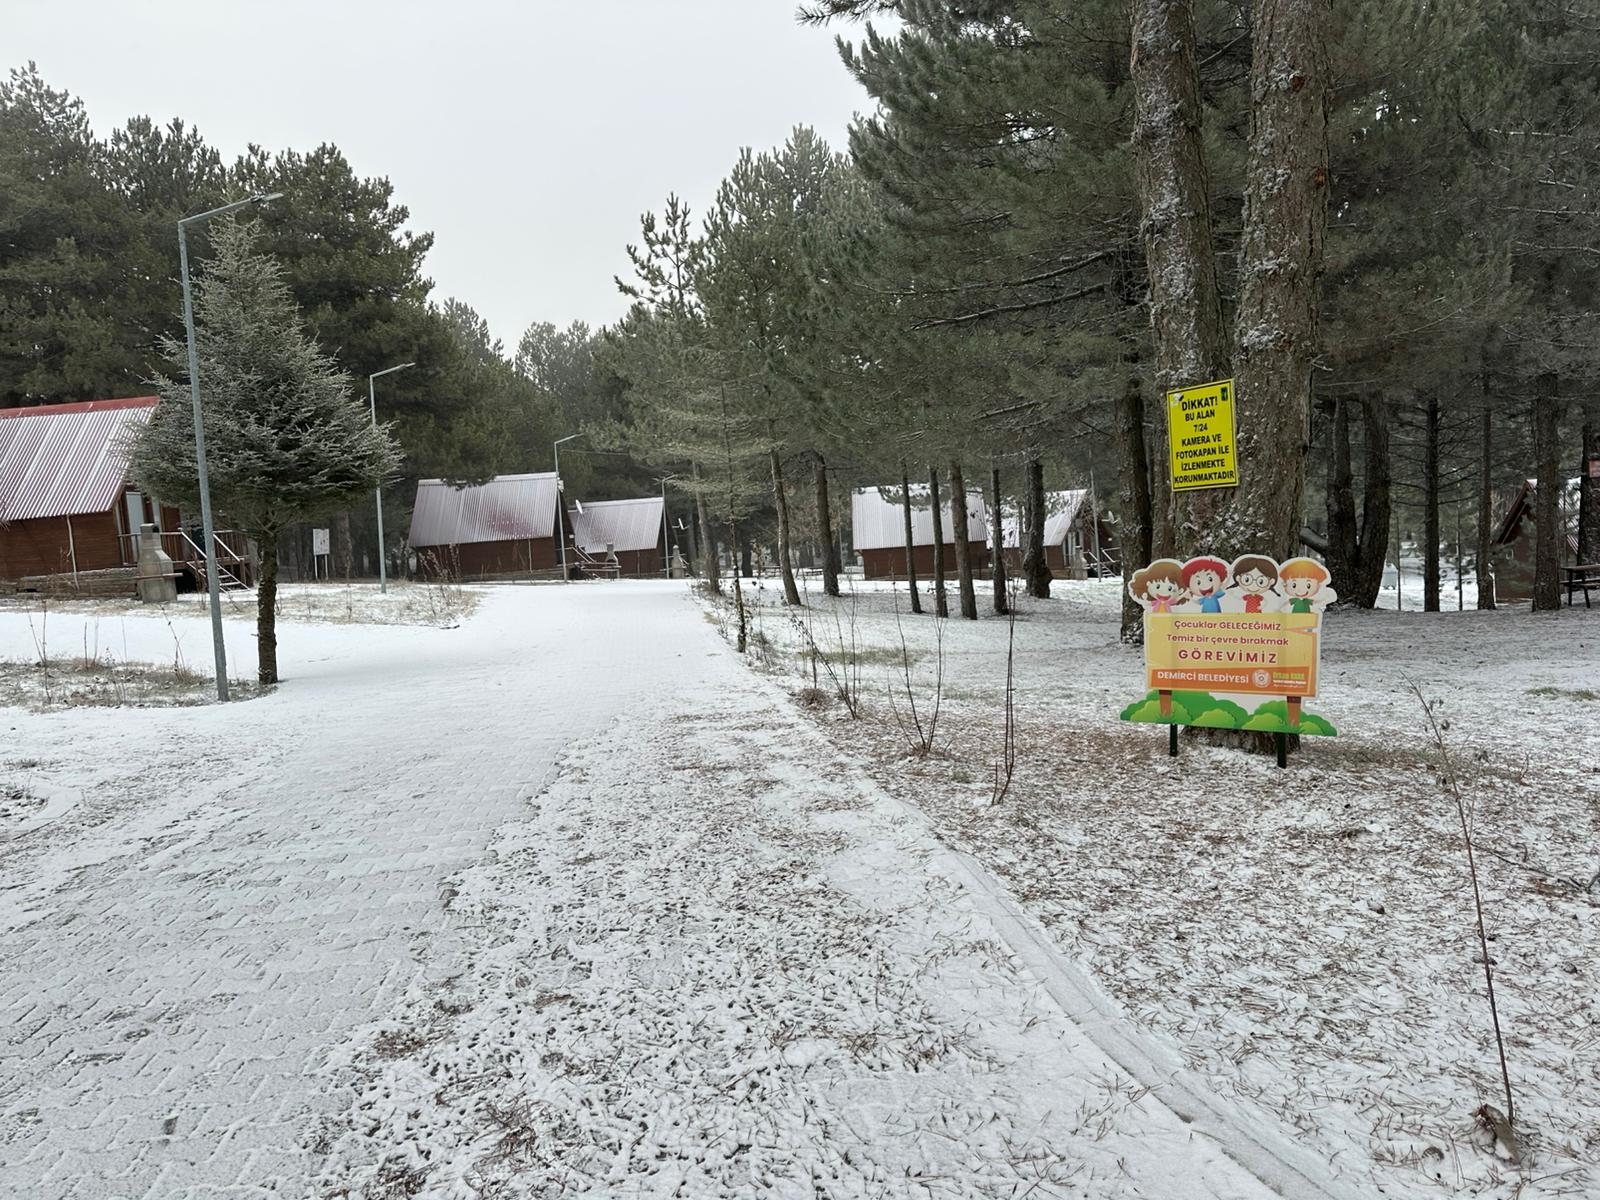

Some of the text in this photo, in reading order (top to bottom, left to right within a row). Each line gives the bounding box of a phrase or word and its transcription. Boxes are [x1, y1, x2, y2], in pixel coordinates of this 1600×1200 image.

[1181, 396, 1218, 411] DİKKAT!
[1185, 409, 1215, 421] BU ALAN
[1181, 434, 1222, 447] KAMERA VE
[1176, 444, 1230, 460] FOTOKAPAN İLE
[1181, 459, 1225, 471] İZLENMEKTE
[1174, 471, 1235, 483] KORUNMAKTADIR
[1174, 620, 1217, 629] Çocuklar
[1167, 634, 1289, 646] Temiz bir çevre bırakmak
[1178, 647, 1277, 664] GÖREVİMİZ
[1157, 671, 1249, 684] DEMİRCİ BELEDİYESİ
